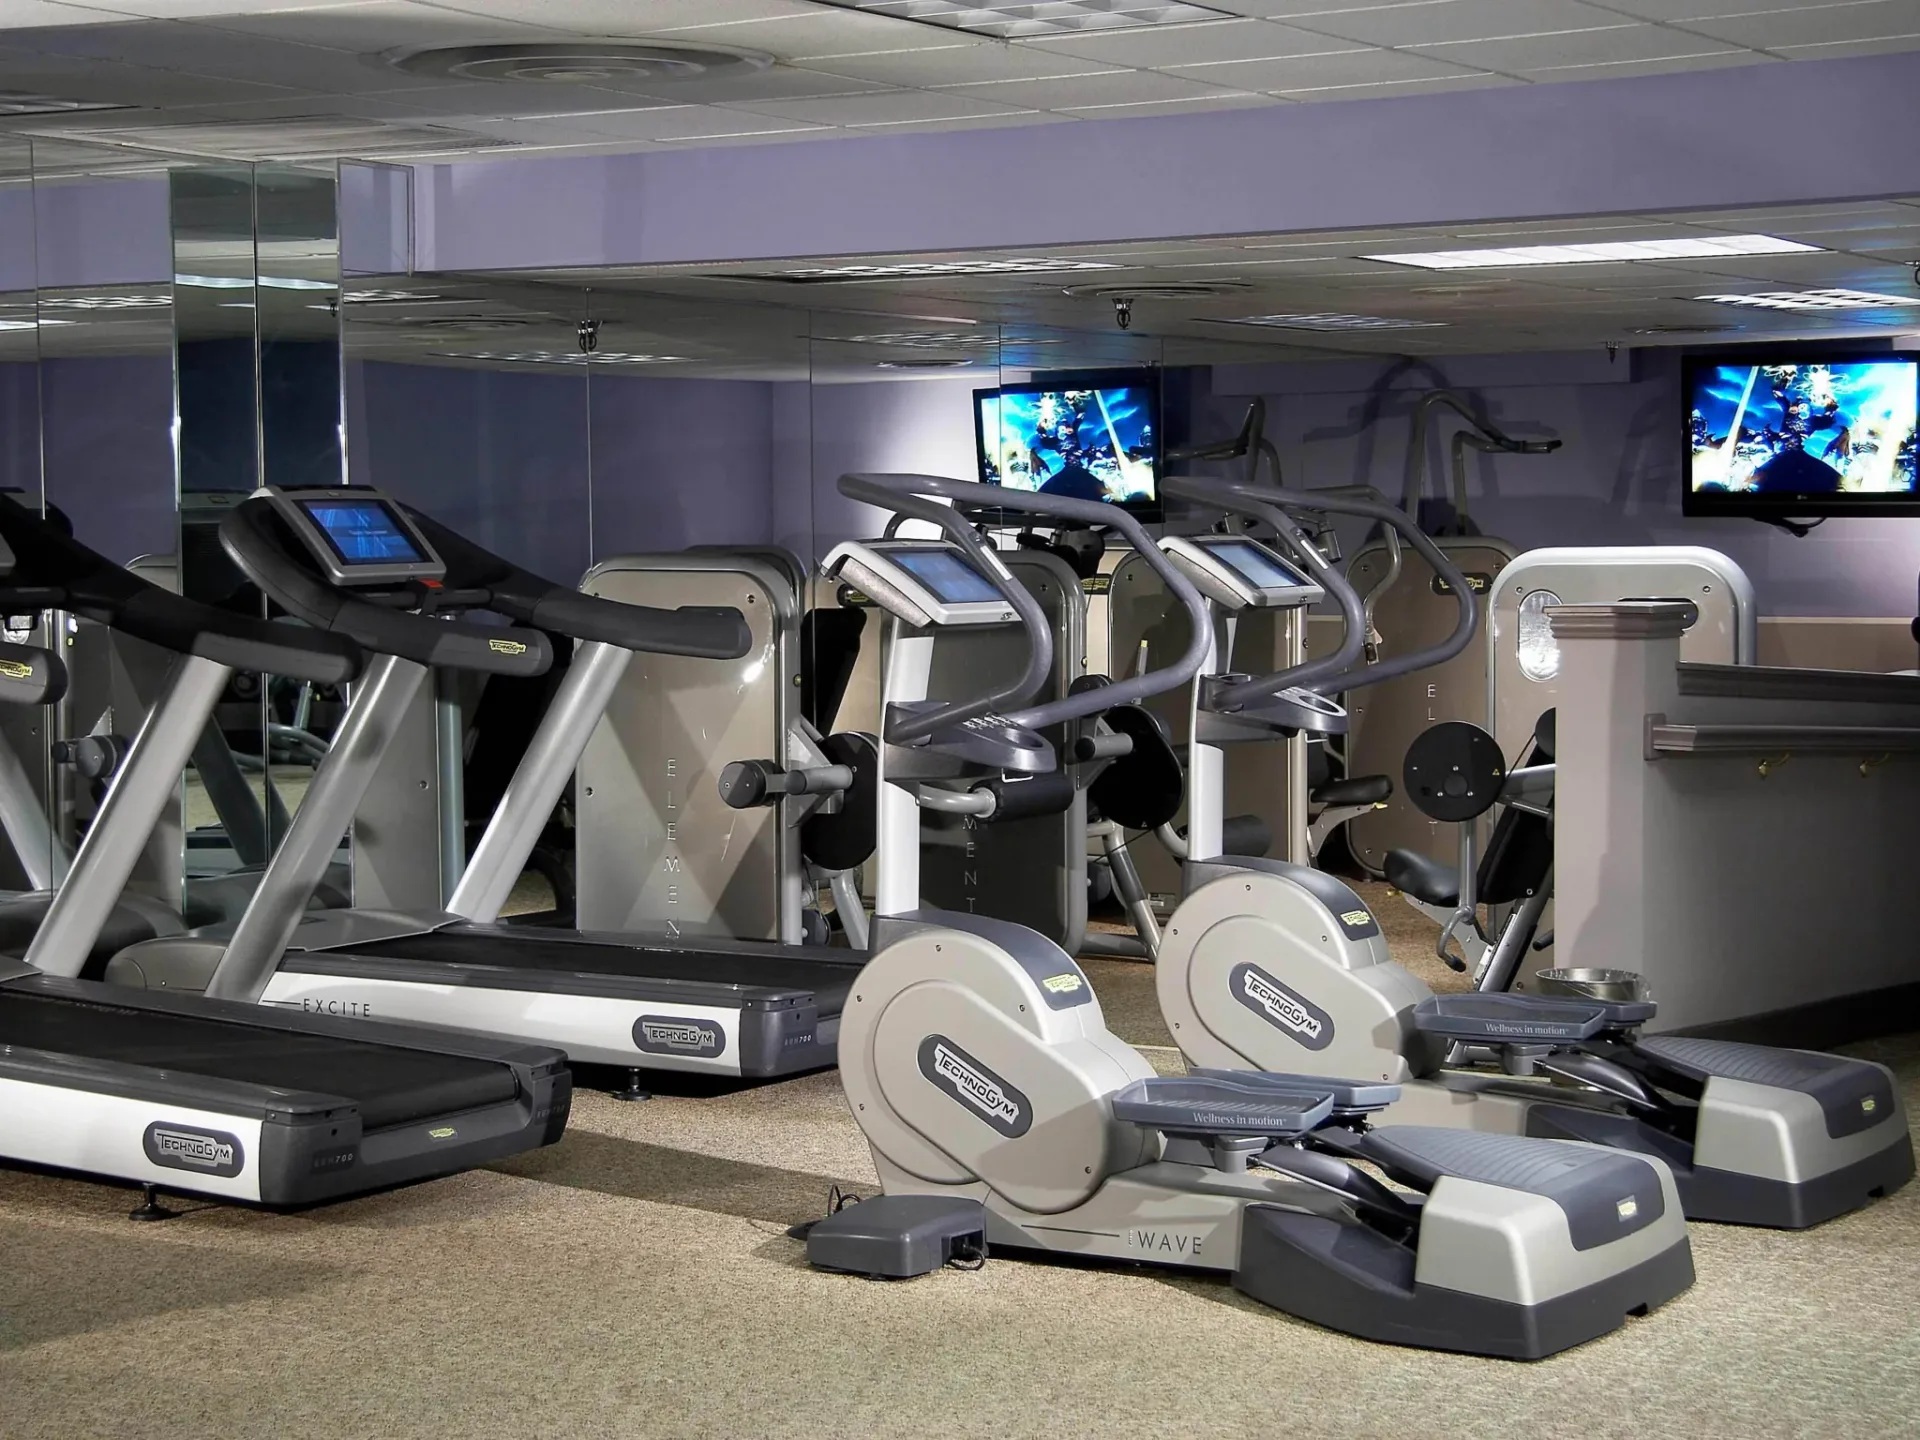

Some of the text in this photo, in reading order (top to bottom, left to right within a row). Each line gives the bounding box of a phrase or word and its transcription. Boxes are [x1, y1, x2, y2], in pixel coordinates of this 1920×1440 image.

[303, 998, 370, 1017] EXCITE
[1247, 973, 1318, 1033] TECHNOGYM
[643, 1024, 713, 1045] TECHNOGYM
[1485, 1023, 1566, 1035] Wellness in motion
[937, 1048, 1016, 1117] TECHNOGYM
[1192, 1112, 1283, 1126] Wellness in motion
[156, 1132, 230, 1161] TECHNOGYM
[1138, 1230, 1202, 1255] WAVE
